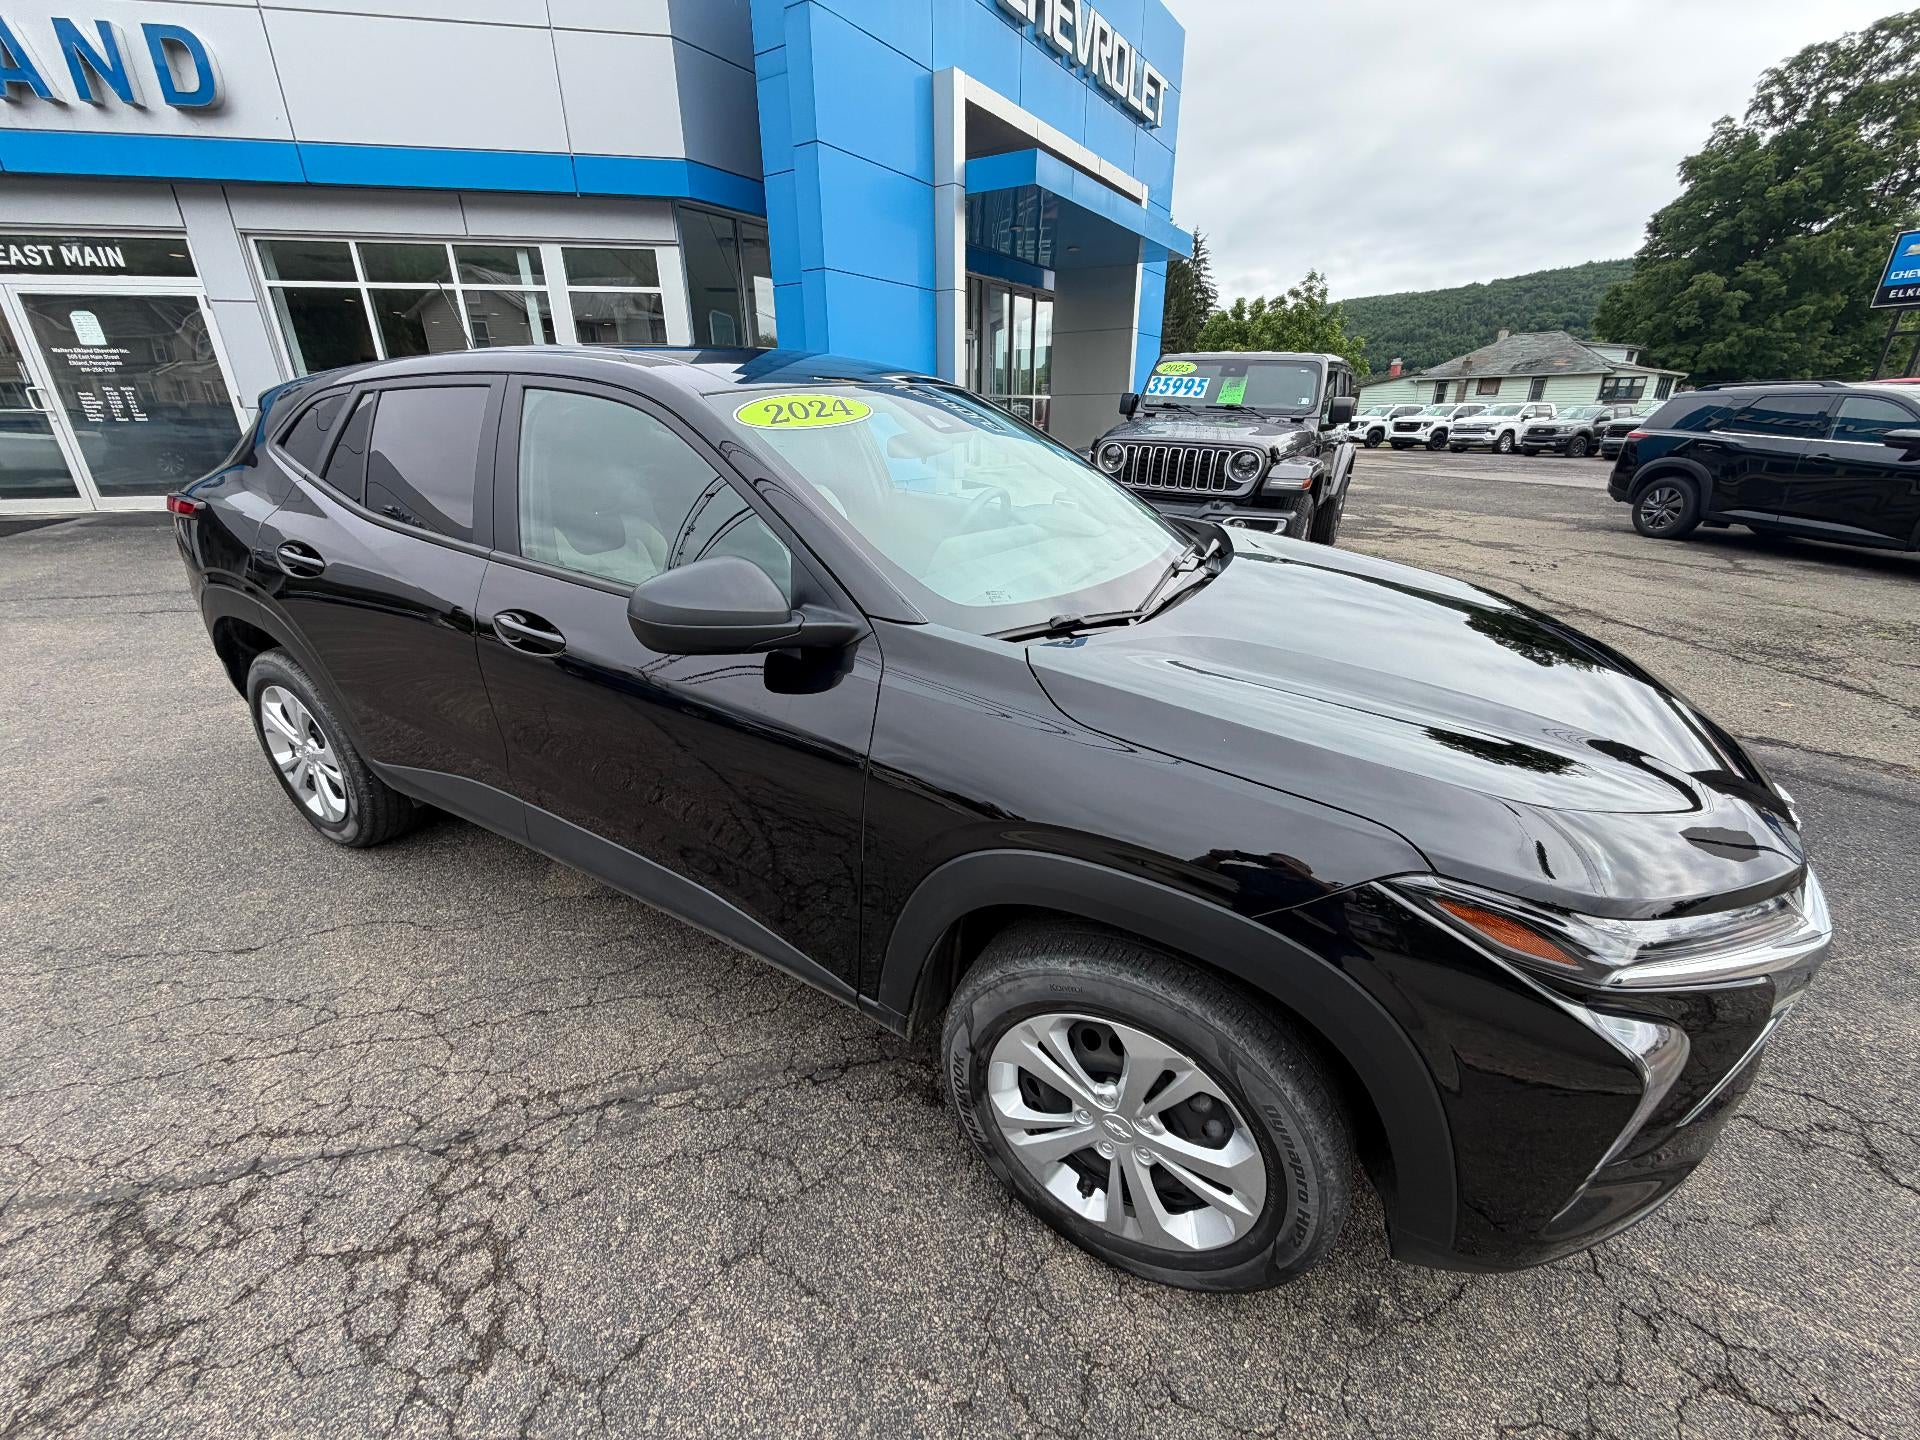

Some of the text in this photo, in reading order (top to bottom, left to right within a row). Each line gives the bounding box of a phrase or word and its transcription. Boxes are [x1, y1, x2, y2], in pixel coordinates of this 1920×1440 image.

[59, 245, 126, 267] MAIN
[1163, 362, 1191, 373] 2025
[1147, 376, 1209, 397] 35995
[763, 399, 855, 425] 2024
